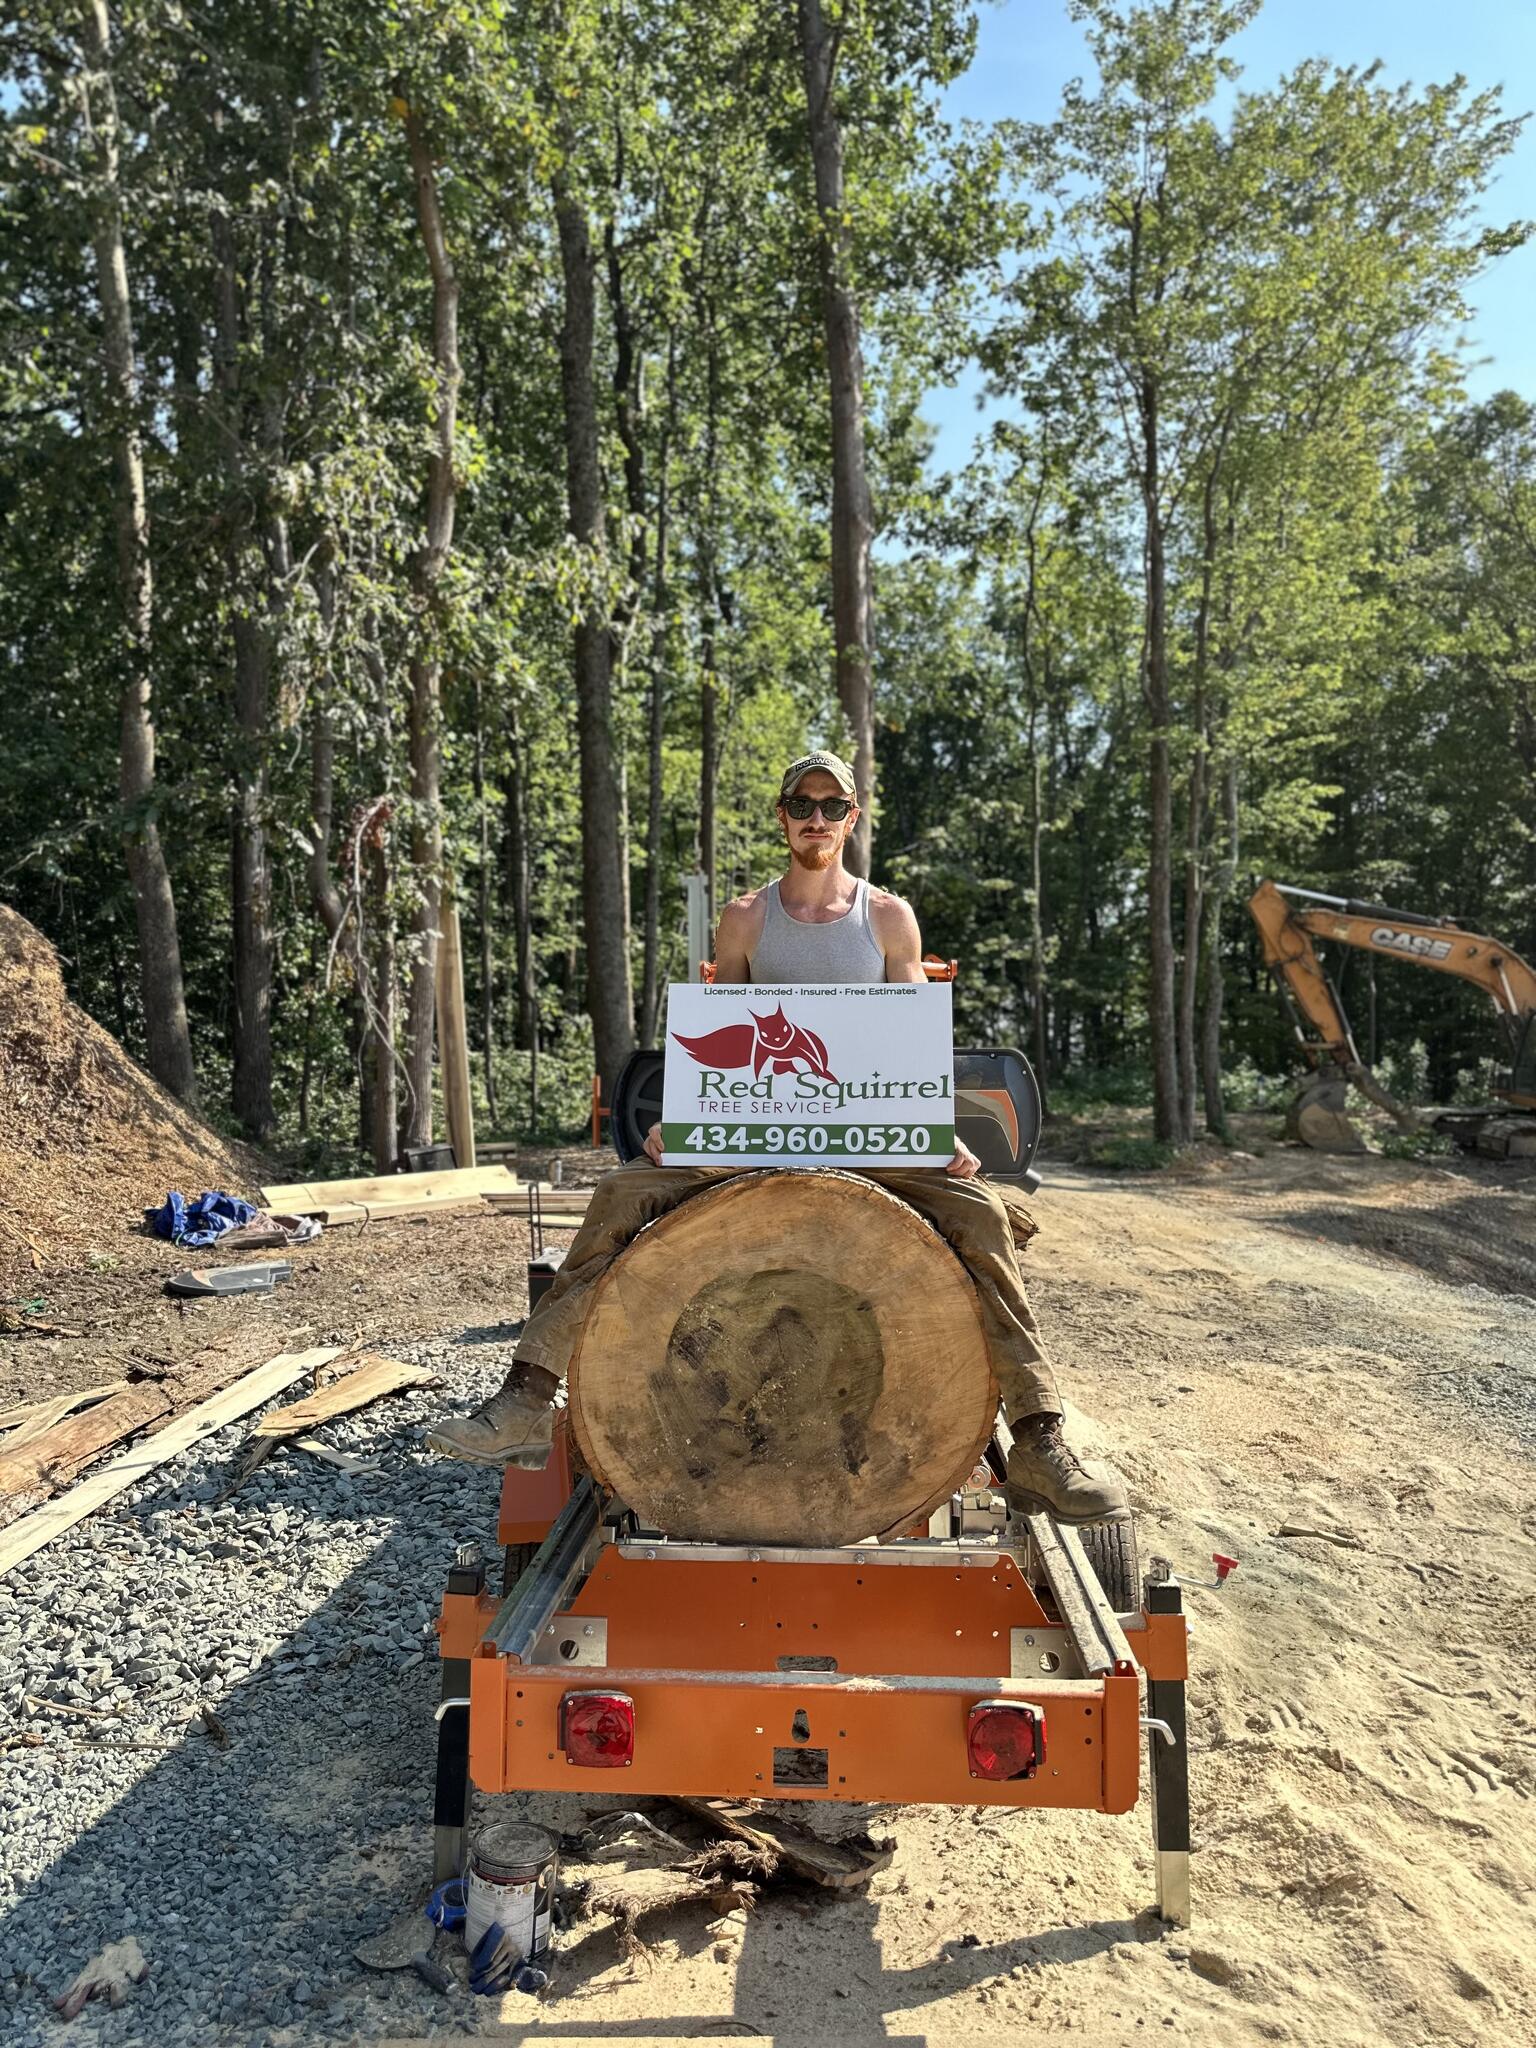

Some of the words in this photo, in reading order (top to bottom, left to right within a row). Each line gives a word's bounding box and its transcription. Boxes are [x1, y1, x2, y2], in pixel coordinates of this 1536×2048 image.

[1371, 928, 1453, 960] CASE
[704, 987, 746, 996] Licensed
[754, 987, 793, 996] Bonded
[800, 987, 837, 996] Insured
[845, 987, 866, 996] Free
[869, 987, 917, 996] Estimates
[697, 1071, 773, 1099] Red
[795, 1071, 952, 1109] Squirrel
[699, 1101, 742, 1113] TREE
[750, 1101, 831, 1114] SERVICE
[685, 1126, 930, 1152] 434-960-0520
